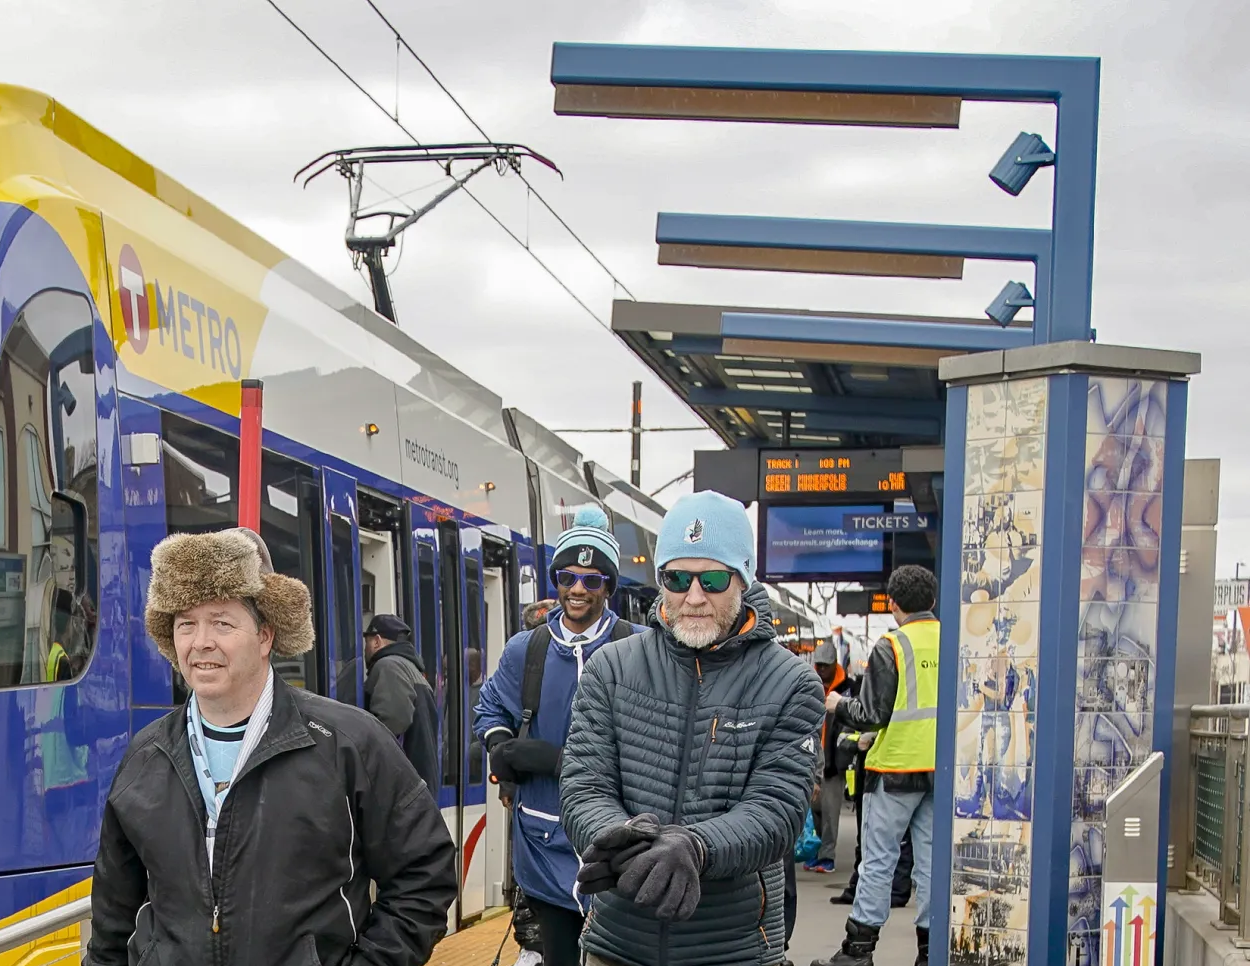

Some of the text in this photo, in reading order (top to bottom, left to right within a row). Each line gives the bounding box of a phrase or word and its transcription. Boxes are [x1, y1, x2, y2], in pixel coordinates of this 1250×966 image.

[155, 278, 241, 380] METRO
[405, 438, 459, 490] metrotransit.org
[766, 458, 792, 469] TRACK
[852, 516, 909, 529] TICKETS
